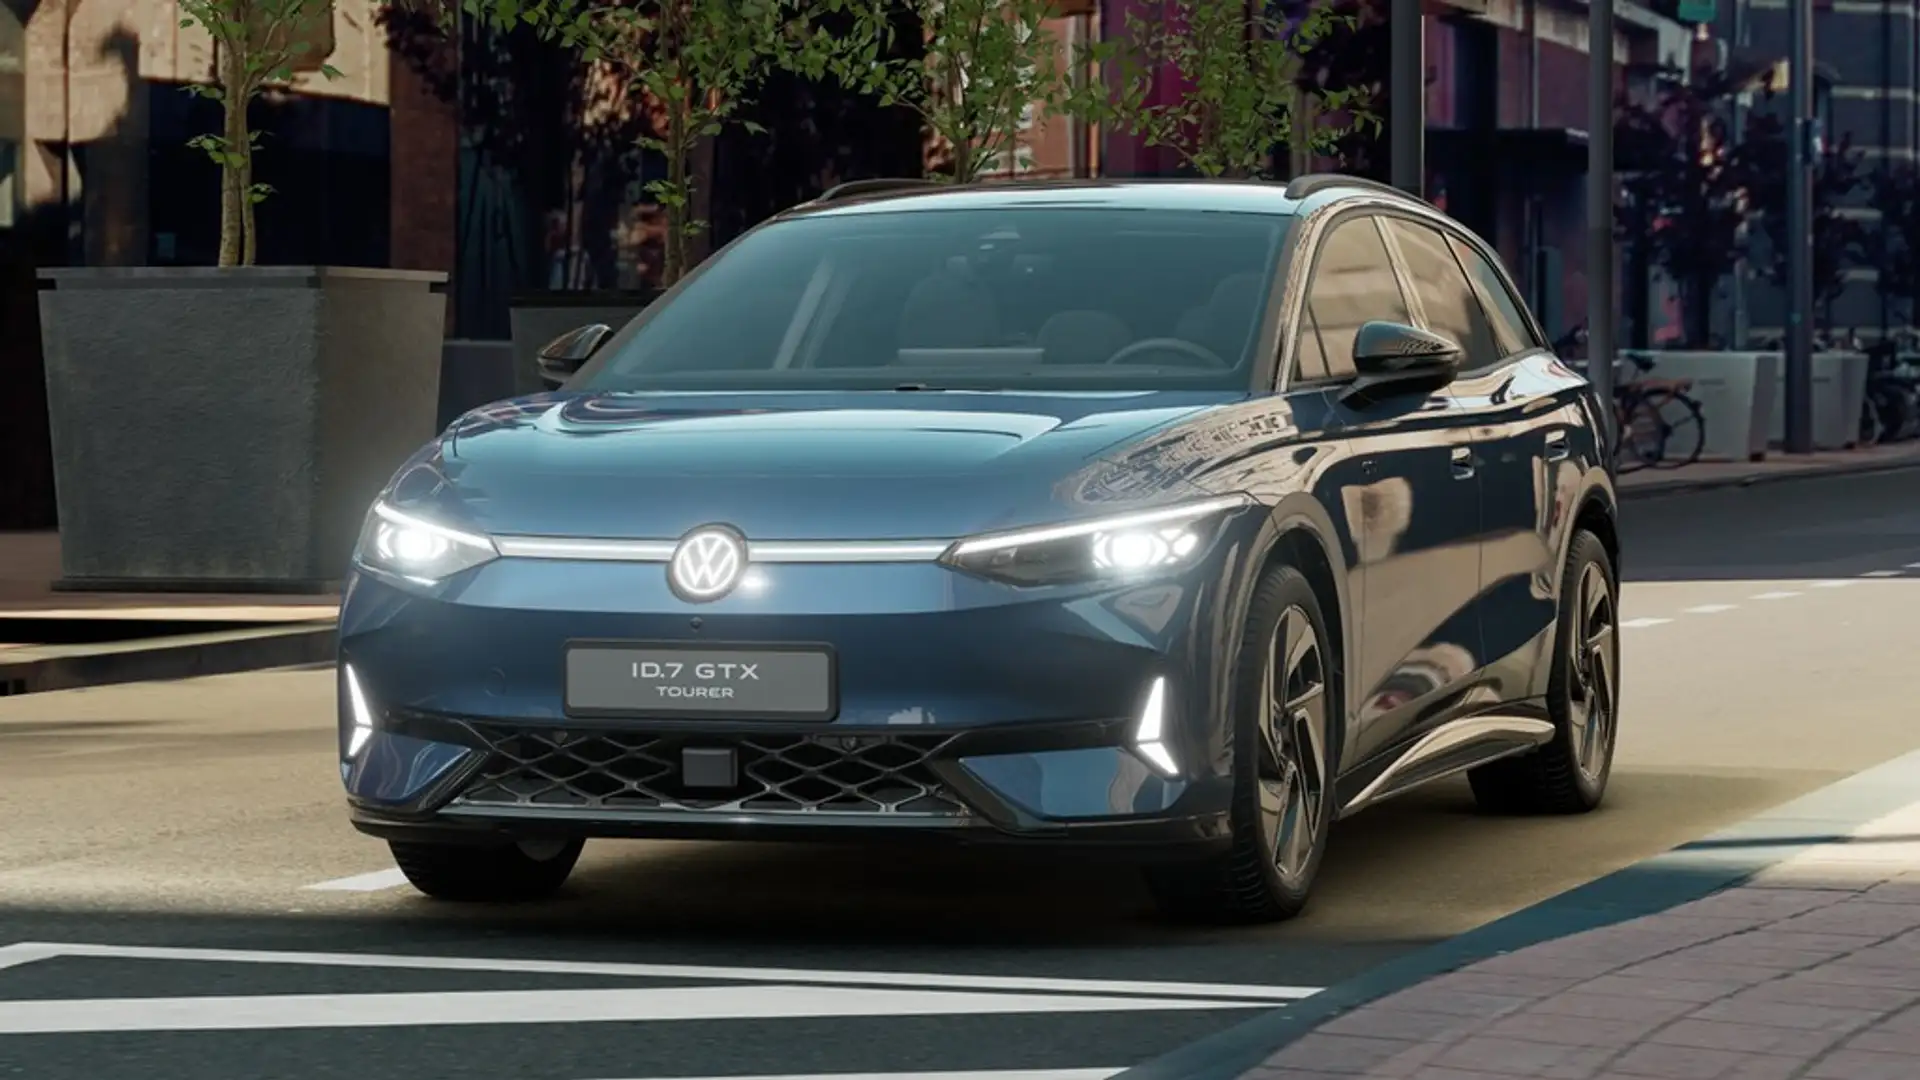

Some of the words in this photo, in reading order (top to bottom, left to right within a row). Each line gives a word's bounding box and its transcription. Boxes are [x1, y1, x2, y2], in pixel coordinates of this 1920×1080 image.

[674, 531, 739, 595] VW
[632, 662, 684, 679] ID.7
[695, 663, 760, 680] GTX
[656, 686, 735, 699] TOURER
